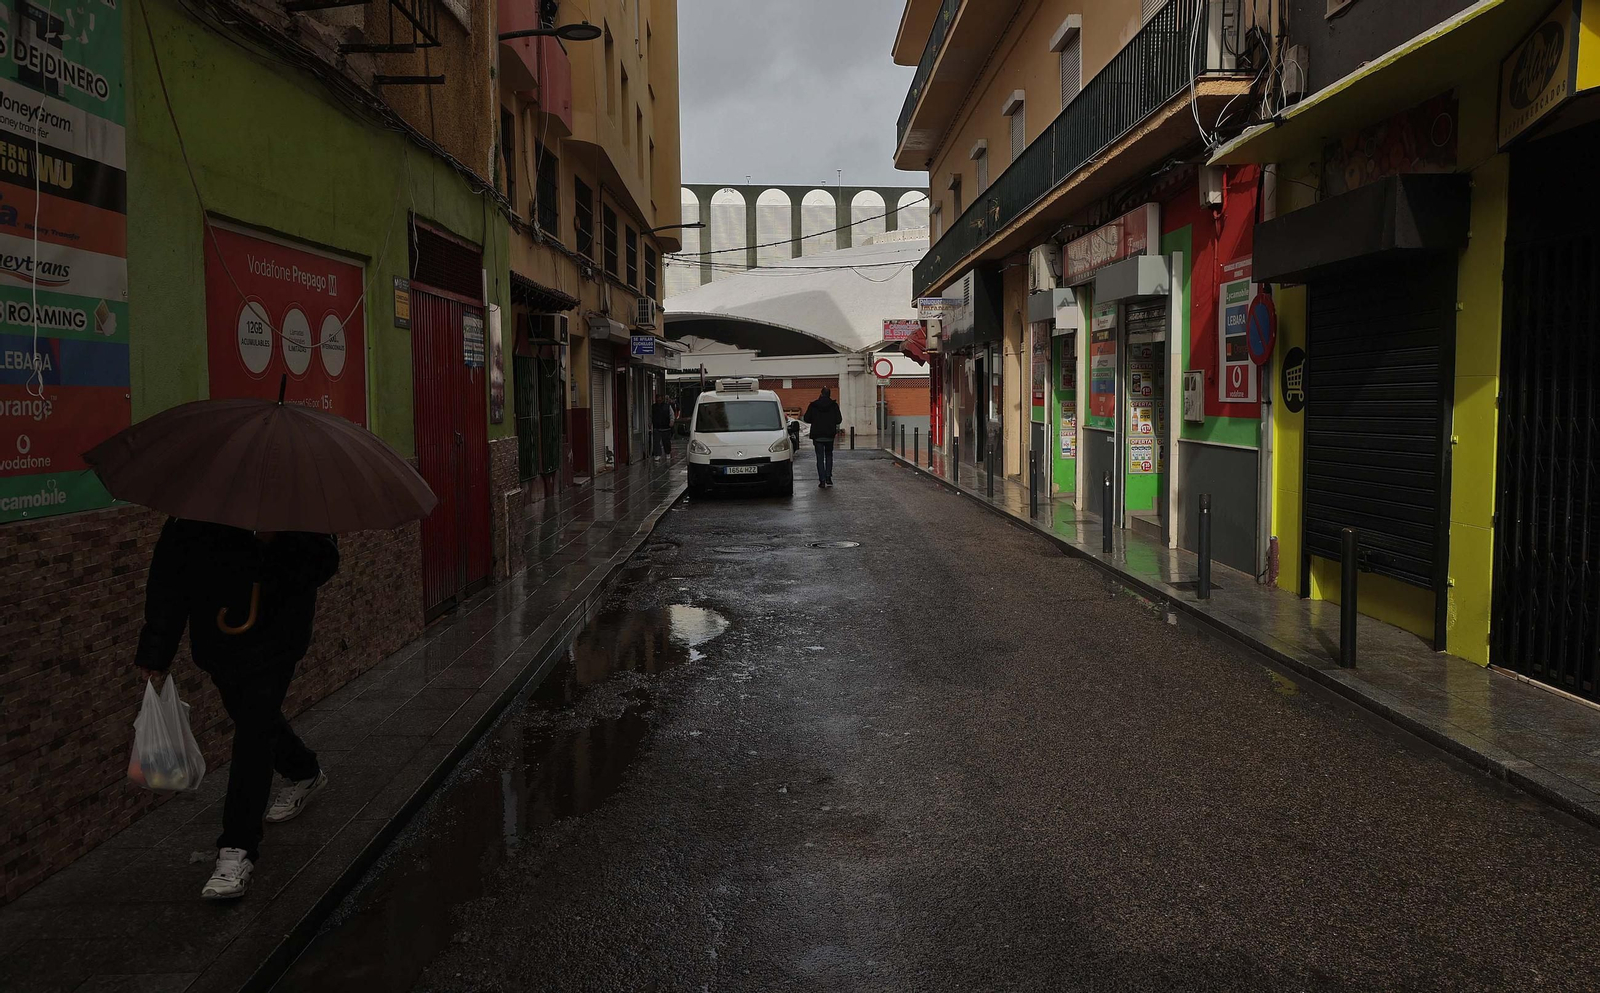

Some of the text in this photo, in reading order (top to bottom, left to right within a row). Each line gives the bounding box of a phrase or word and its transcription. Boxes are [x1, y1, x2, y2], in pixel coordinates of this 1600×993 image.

[14, 38, 39, 69] DE
[45, 53, 108, 98] DINERO
[0, 91, 71, 133] oneyGram
[1503, 79, 1567, 139] SUPERMERCADOS
[0, 253, 70, 278] eytrans
[247, 253, 291, 282] Vodafone
[292, 265, 327, 293] Prepago
[8, 304, 86, 328] ROAMING
[246, 320, 264, 336] 12GB
[1227, 313, 1246, 327] LEBARA
